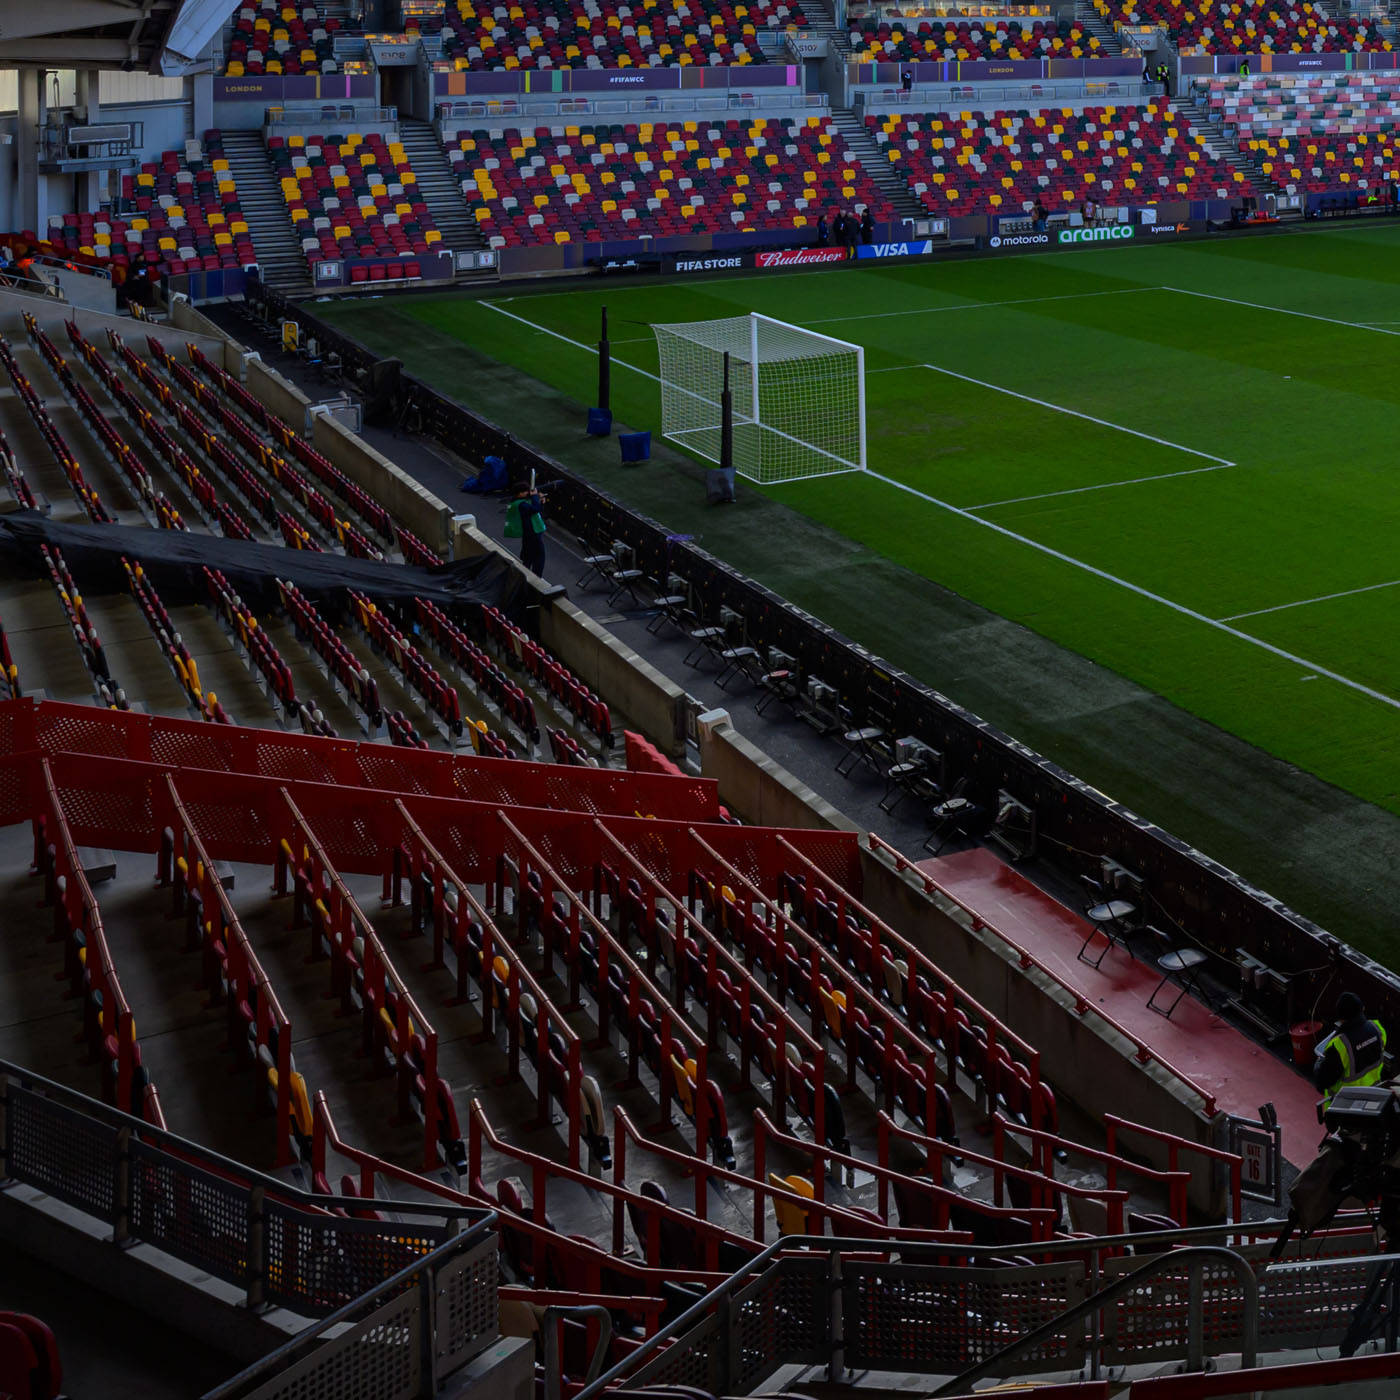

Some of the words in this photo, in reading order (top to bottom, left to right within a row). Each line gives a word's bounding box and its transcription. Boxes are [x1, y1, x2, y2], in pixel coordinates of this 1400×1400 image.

[225, 85, 262, 93] LONDON
[1060, 225, 1133, 243] aramco
[1151, 224, 1175, 234] kynisca
[1002, 234, 1048, 246] motorola
[872, 243, 909, 257] VISA
[676, 260, 703, 272] FIFA
[704, 257, 742, 269] STORE
[760, 250, 843, 267] Budweiser
[1248, 1158, 1260, 1181] 16
